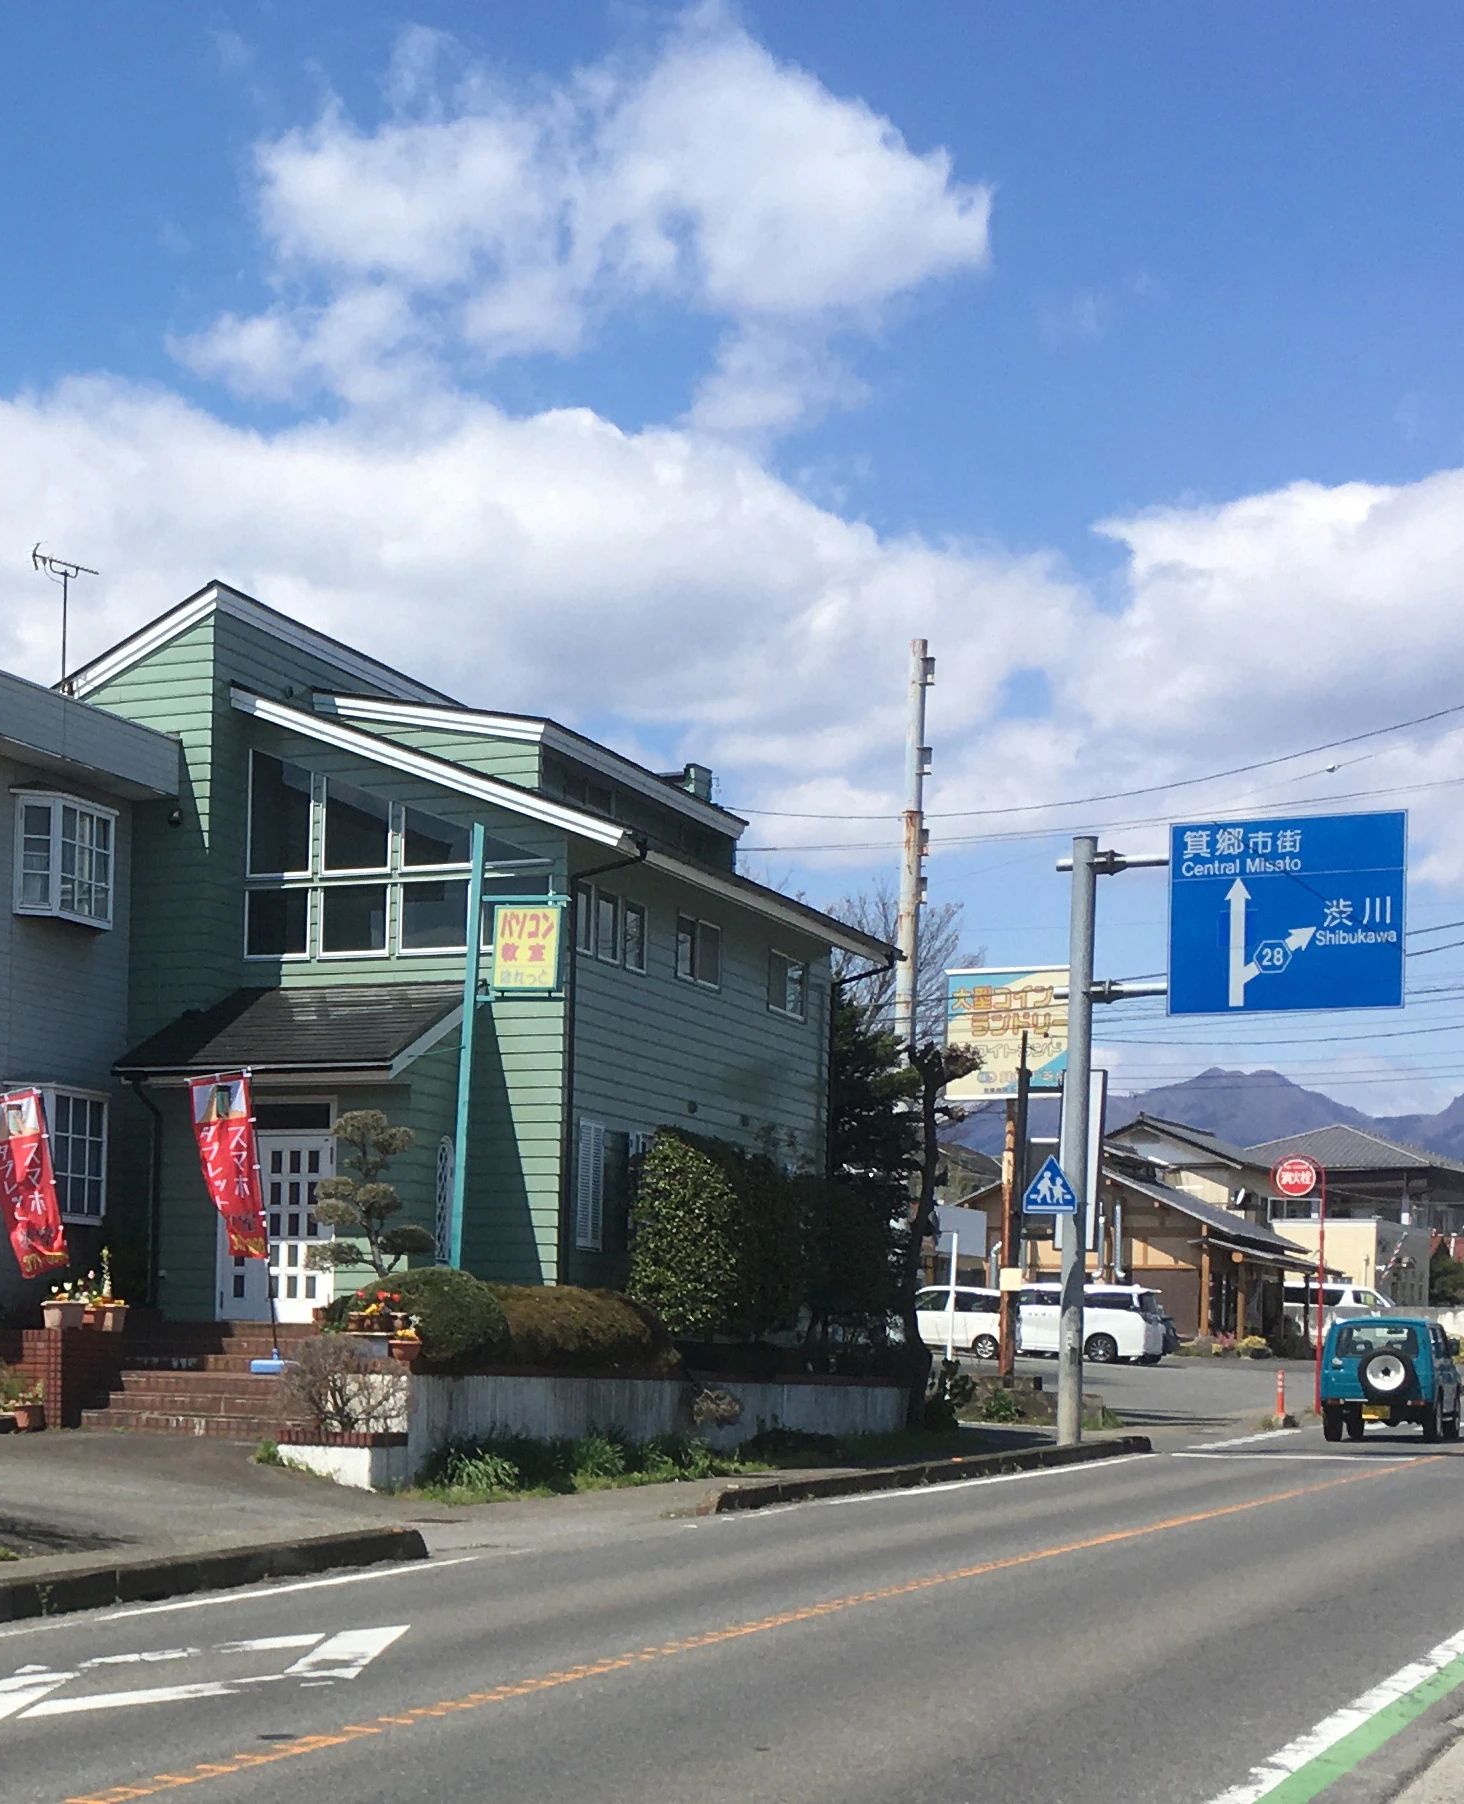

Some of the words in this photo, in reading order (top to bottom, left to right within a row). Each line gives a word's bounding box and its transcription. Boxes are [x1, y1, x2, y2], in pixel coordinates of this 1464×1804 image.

[1183, 828, 1302, 858] 箕郷市街
[1181, 862, 1240, 877] Central
[1246, 857, 1302, 873] Misato
[1323, 896, 1392, 927] 渋川
[500, 911, 554, 939] パソコン
[1315, 930, 1397, 946] Shibukawa
[1262, 948, 1284, 966] 28
[500, 969, 551, 985] れっと
[952, 985, 1054, 1010] 大型コイン
[971, 1011, 1068, 1037] ランドリー
[227, 1126, 250, 1199] スマホ
[22, 1142, 46, 1216] スマホ
